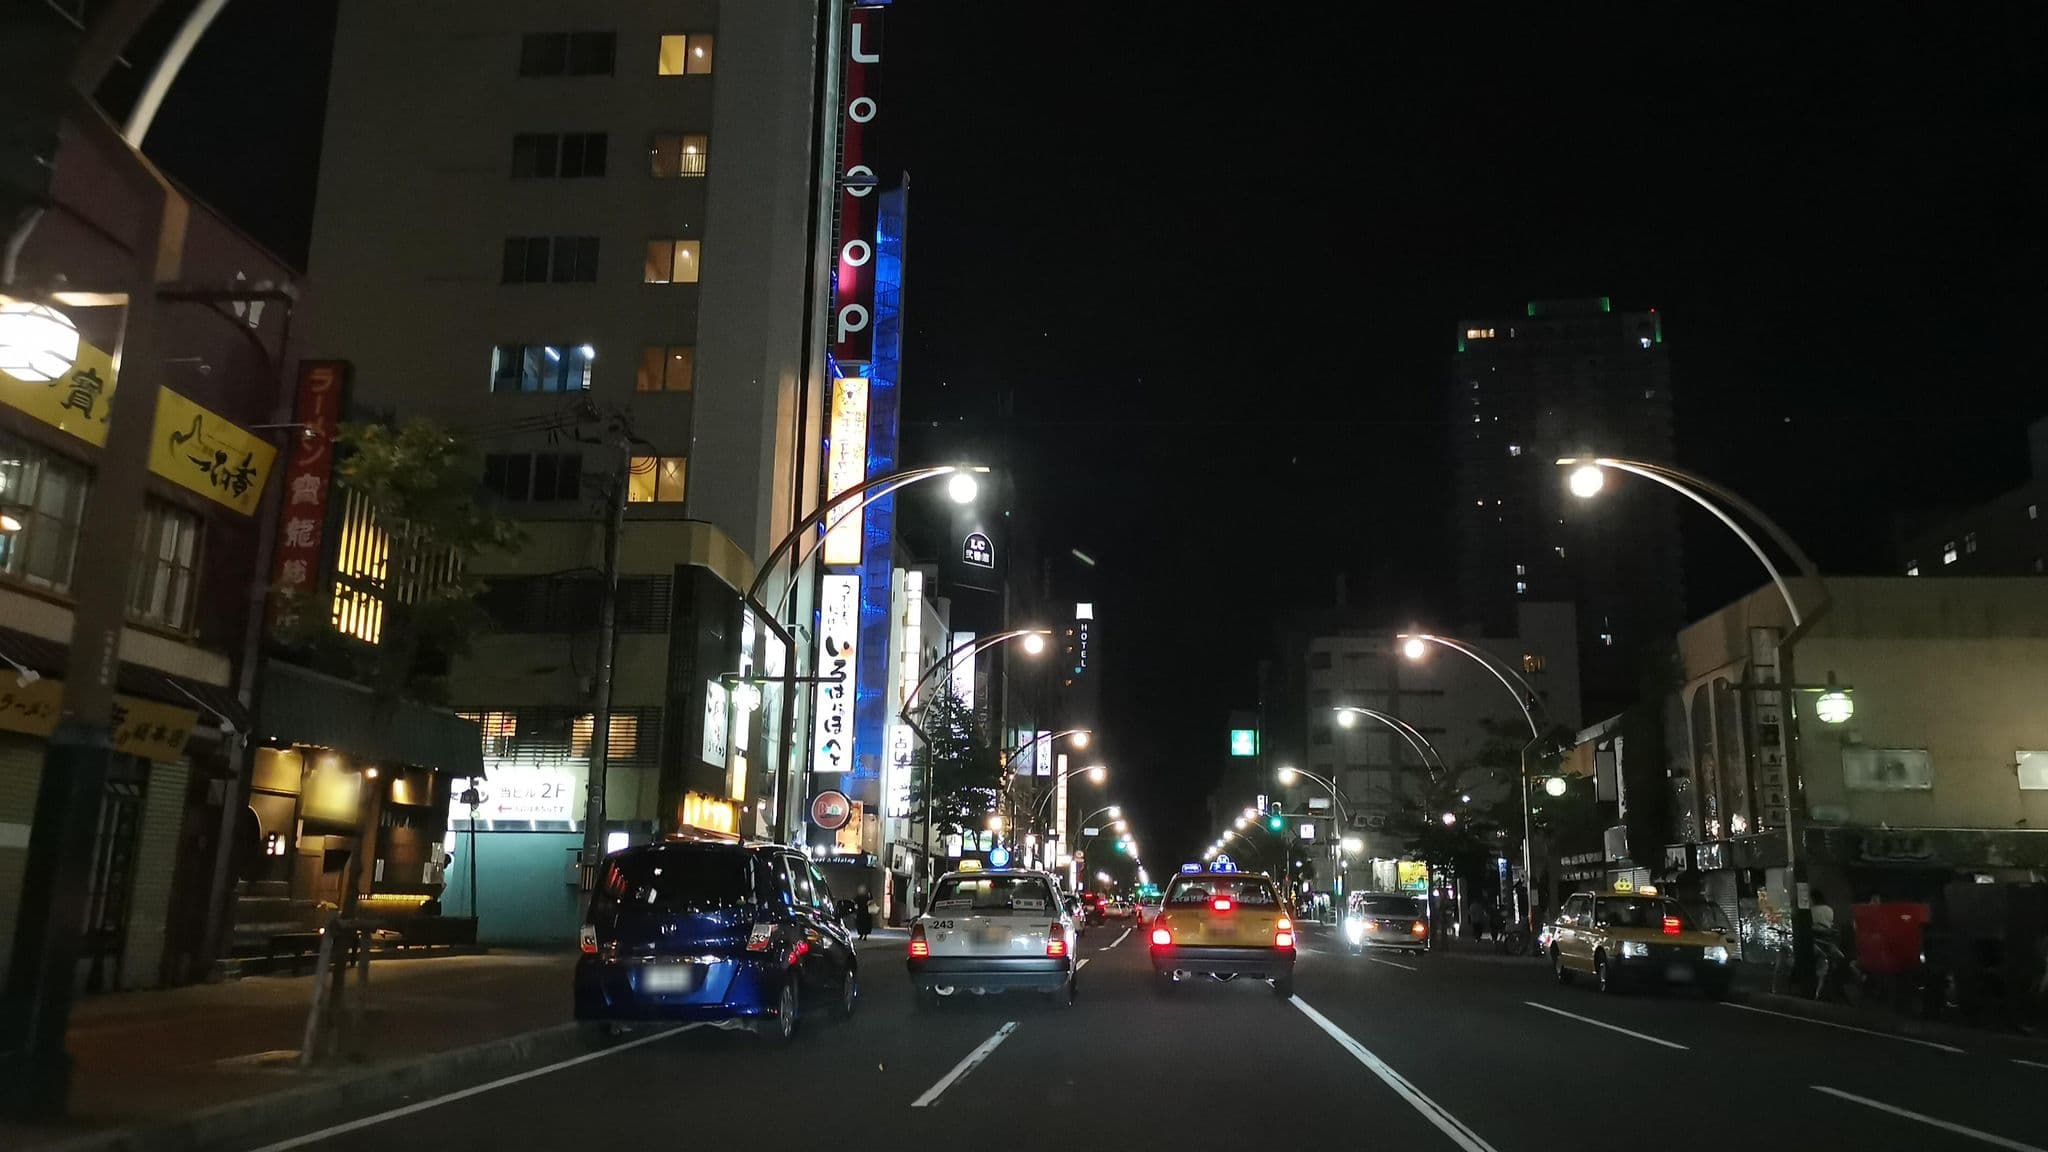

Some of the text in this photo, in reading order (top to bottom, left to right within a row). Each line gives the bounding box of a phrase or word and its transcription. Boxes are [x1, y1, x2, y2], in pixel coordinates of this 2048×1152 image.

[970, 538, 986, 551] LC
[1080, 624, 1088, 667] HOTEL
[824, 635, 850, 767] いろはにほへと
[541, 782, 567, 799] 2F
[933, 920, 954, 929] 243
